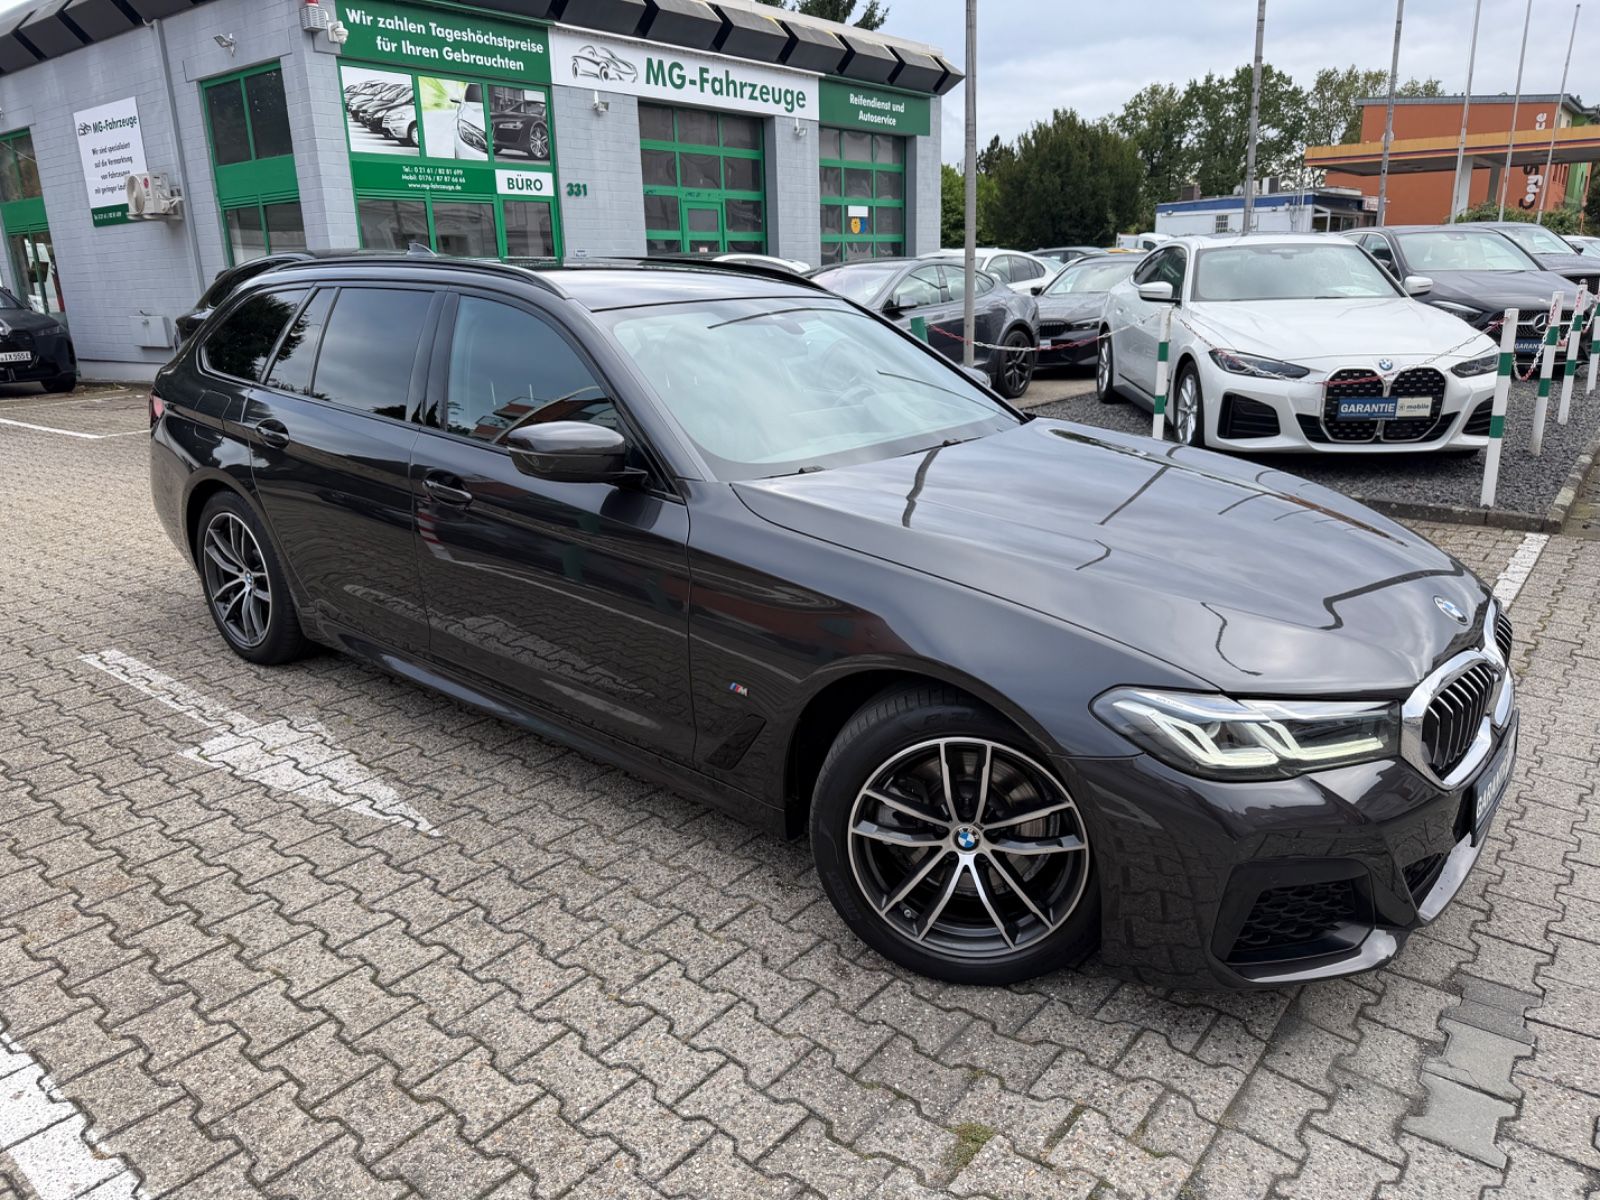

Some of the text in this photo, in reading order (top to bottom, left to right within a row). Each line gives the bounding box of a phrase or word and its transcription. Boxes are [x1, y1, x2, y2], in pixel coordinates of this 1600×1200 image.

[345, 8, 544, 54] Wir zahlen Tageshöchstpreise
[376, 36, 525, 71] für Ihren Gebrauchten
[645, 57, 807, 113] MG-Fahrzeuge
[849, 93, 905, 113] Reifendienst und
[92, 115, 138, 134] MG-Fahrzeuge
[858, 110, 897, 126] Autoservice
[507, 174, 544, 192] BÜRO
[566, 182, 588, 197] 331
[1340, 403, 1396, 413] GARANTIE
[1406, 402, 1430, 410] mobile
